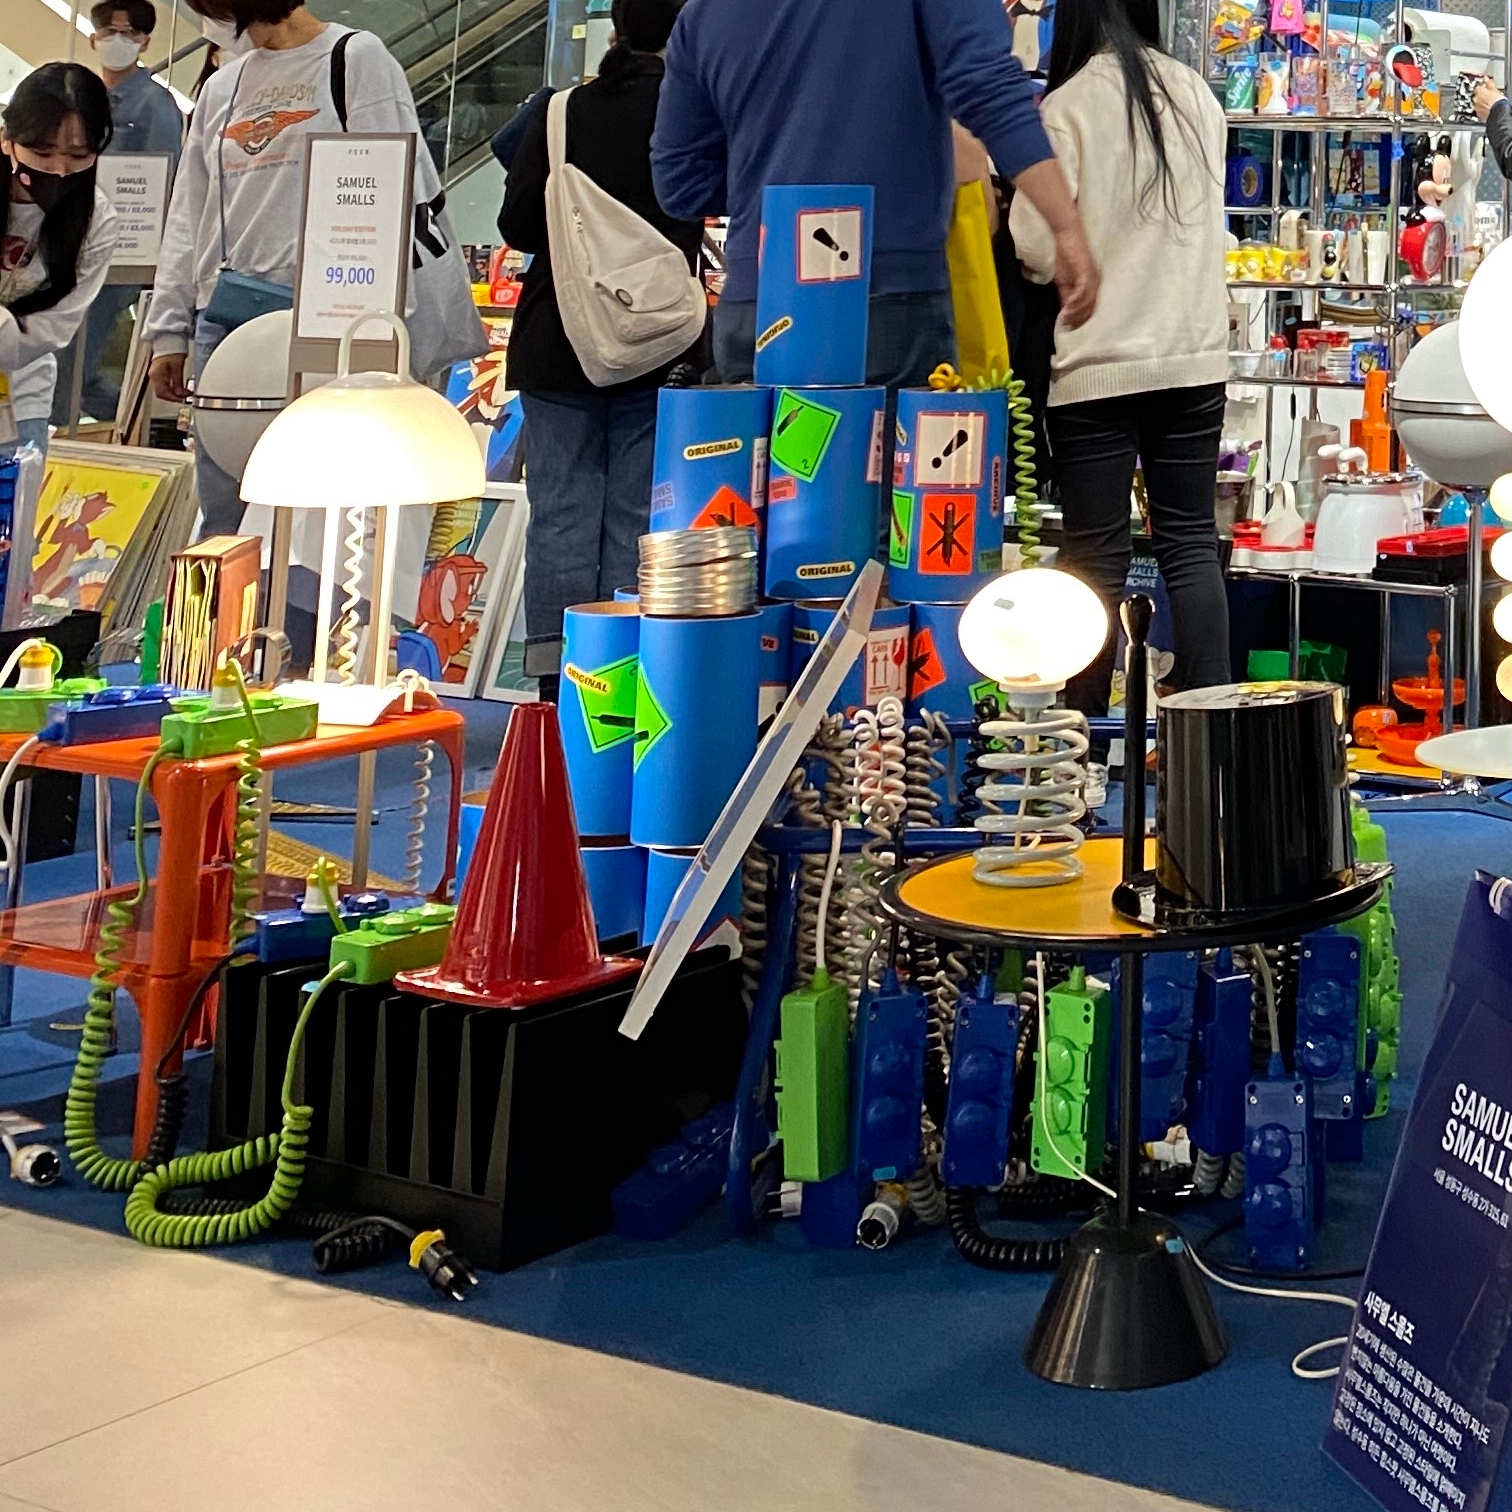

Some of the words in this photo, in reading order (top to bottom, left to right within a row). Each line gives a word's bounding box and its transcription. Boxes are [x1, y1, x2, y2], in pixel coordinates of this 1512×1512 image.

[1226, 67, 1252, 107] Sprite
[336, 176, 378, 189] SAMUEL
[336, 193, 376, 206] SMALLS
[325, 266, 375, 288] 99,000
[687, 440, 741, 457] ORIGINAL
[799, 562, 853, 578] ORIGINAL
[1129, 556, 1159, 568] AMUEL
[1126, 567, 1159, 578] MALLS
[1125, 577, 1157, 588] RCHIVE
[567, 666, 608, 693] ORIGINAL
[1364, 1290, 1391, 1327] 사무엘
[1387, 1310, 1416, 1346] 스몰즈
